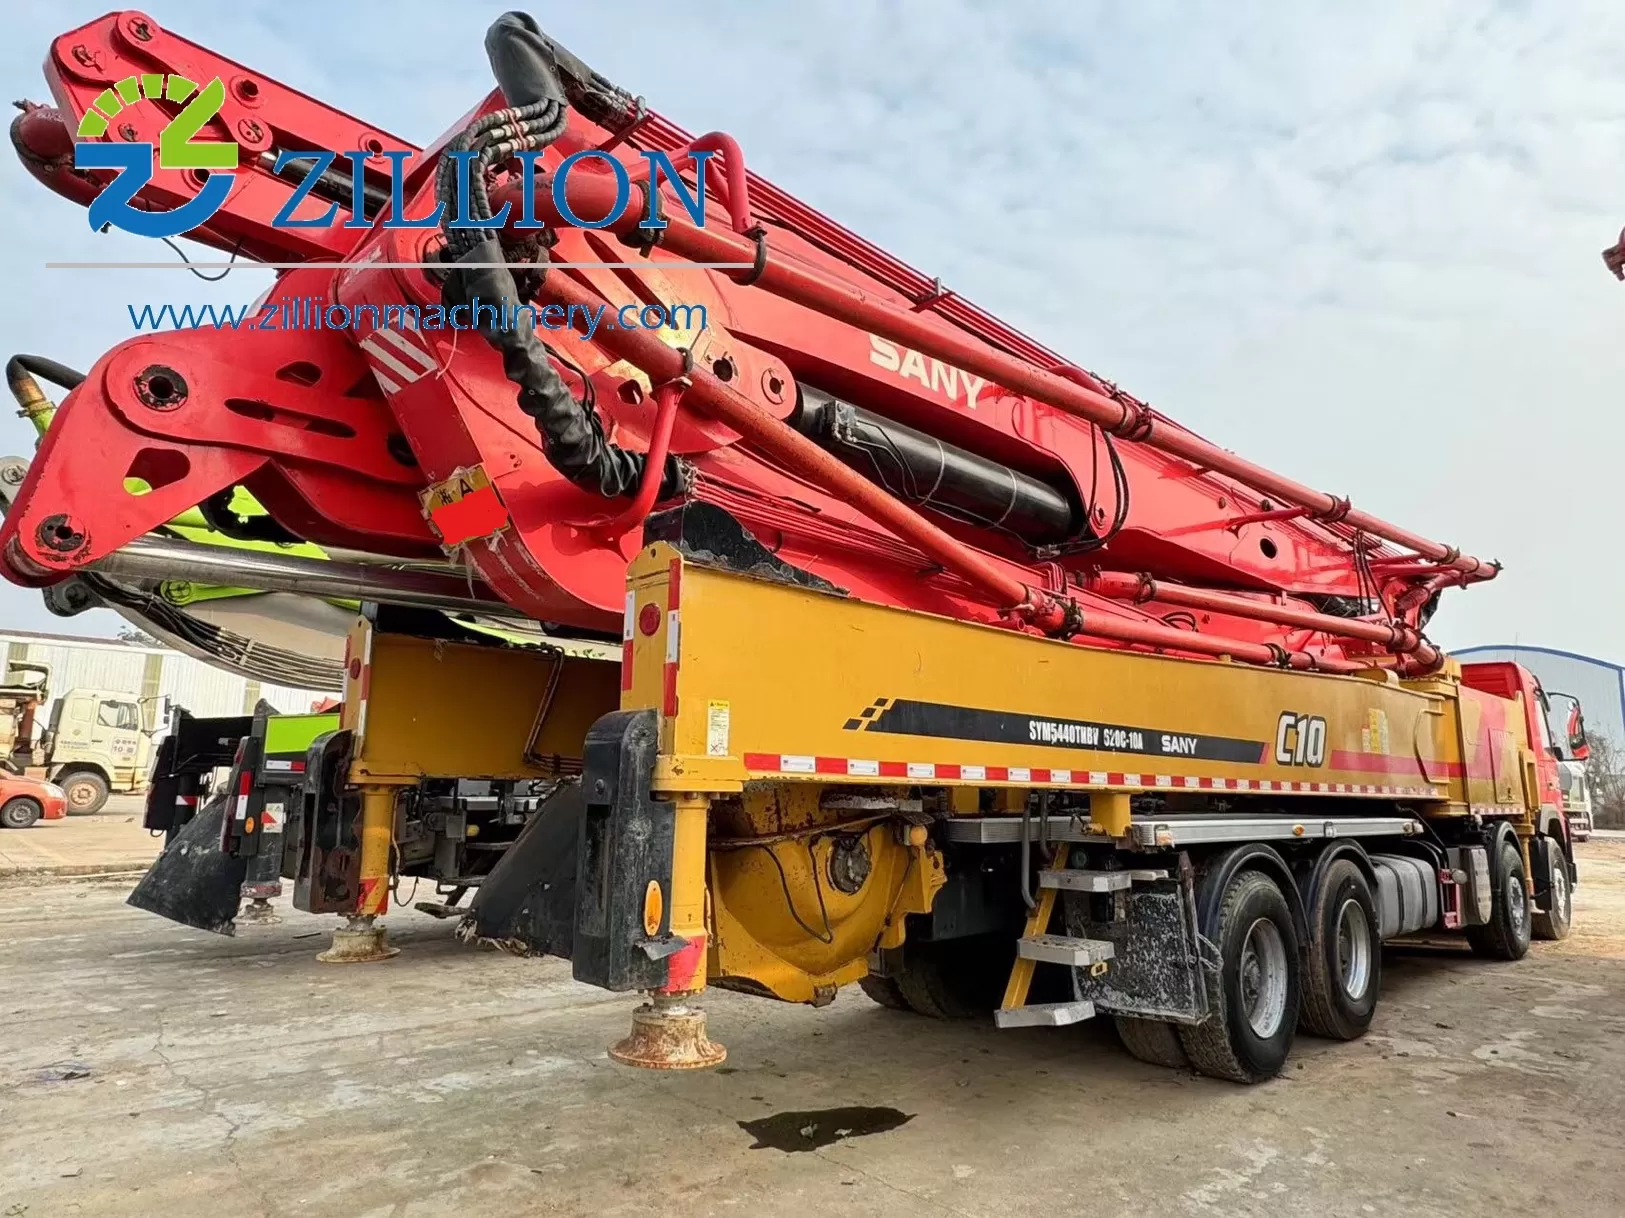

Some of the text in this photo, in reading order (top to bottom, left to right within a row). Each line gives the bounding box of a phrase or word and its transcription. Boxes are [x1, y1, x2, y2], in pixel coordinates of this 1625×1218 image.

[868, 334, 985, 410] SANY
[1161, 734, 1198, 754] SANY
[1275, 710, 1327, 768] C10
